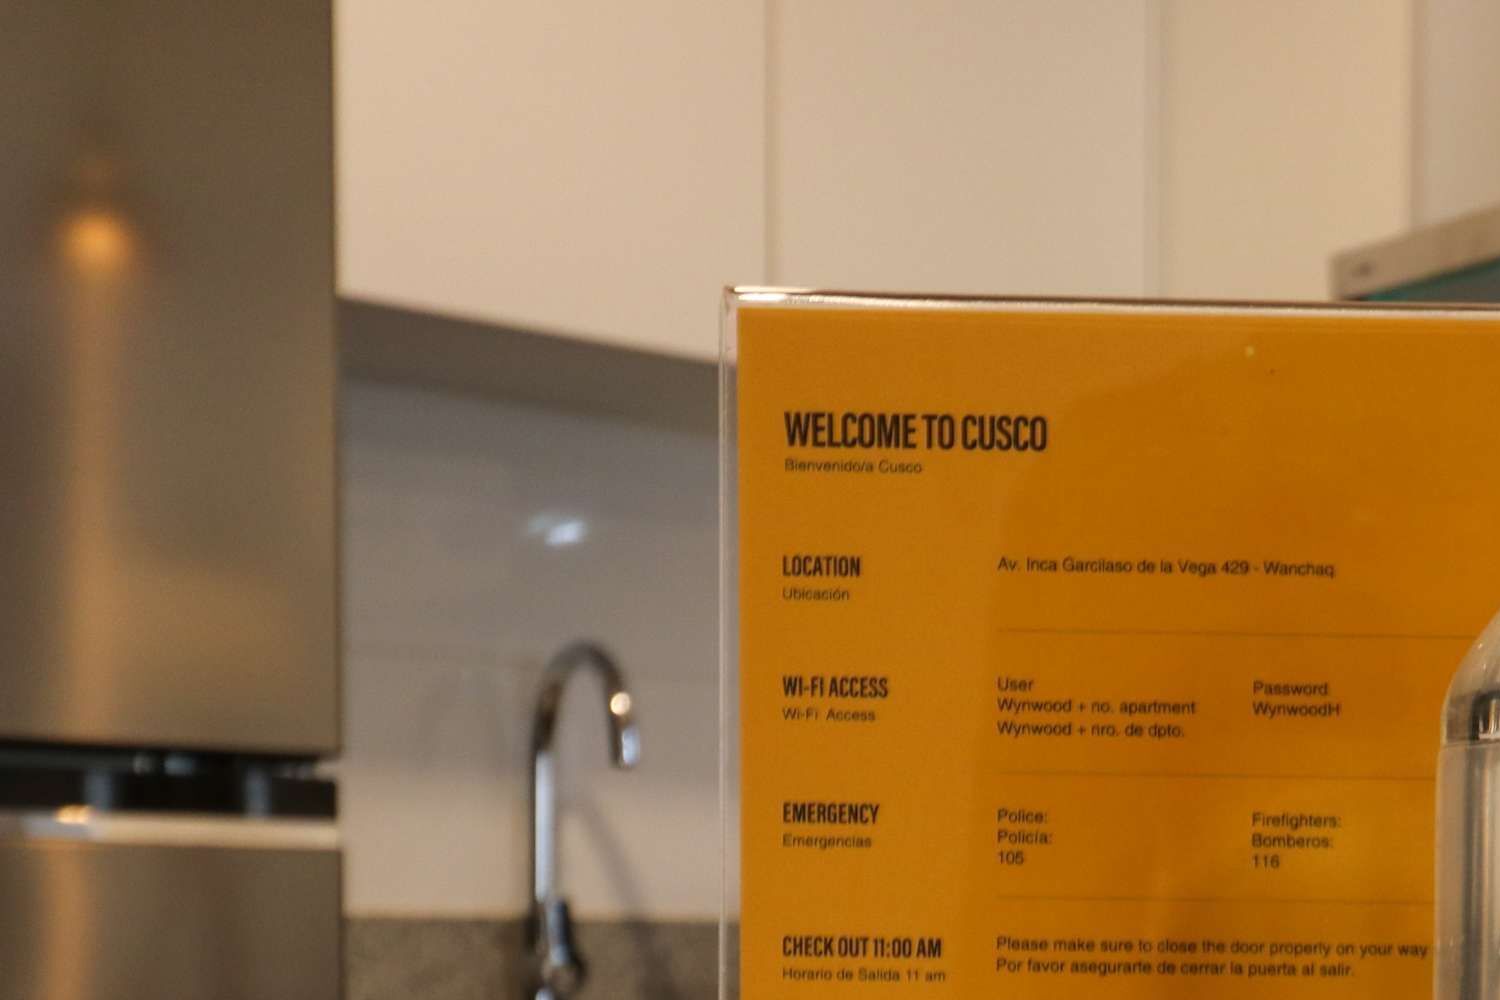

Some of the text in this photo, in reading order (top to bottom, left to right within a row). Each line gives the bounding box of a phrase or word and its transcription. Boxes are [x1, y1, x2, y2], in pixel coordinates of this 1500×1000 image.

[783, 411, 1048, 453] WELCOME TO CUSCO
[784, 458, 923, 475] Bienvenido/a Cusco
[782, 555, 861, 578] LOCATION
[1026, 556, 1059, 573] Inca
[1061, 556, 1134, 574] Garcilaso
[1136, 559, 1157, 574] de
[1159, 559, 1174, 575] la
[1177, 559, 1218, 578] Vega
[1220, 559, 1251, 576] 429
[782, 674, 889, 699] WI-FI ACCESS
[997, 676, 1034, 693] User
[1252, 680, 1329, 698] Password
[781, 706, 877, 723] Wi-Fi Access
[996, 698, 1073, 716] Wynwood
[1119, 700, 1197, 718] apartment
[996, 721, 1073, 739] Wynwood
[1124, 722, 1144, 738] de
[782, 802, 880, 825] EMERGENCY
[997, 807, 1048, 824] Police:
[1251, 812, 1341, 831] Firefighters:
[782, 833, 873, 851] Emergencias
[998, 849, 1025, 866] 105
[1253, 853, 1281, 869] 116
[782, 934, 942, 959] CHECK OUT 11:00 AM
[996, 935, 1429, 960] Please make sure to close the door properly on your way
[782, 967, 946, 984] Horario de Salida 11 am
[995, 956, 1023, 974] Por
[1027, 957, 1066, 974] favor
[1070, 960, 1153, 977] asegurarte
[1156, 960, 1177, 975] de
[1180, 962, 1226, 976] cerrar
[1230, 961, 1244, 976] la
[1247, 961, 1297, 978] puerta
[1301, 962, 1315, 977] al
